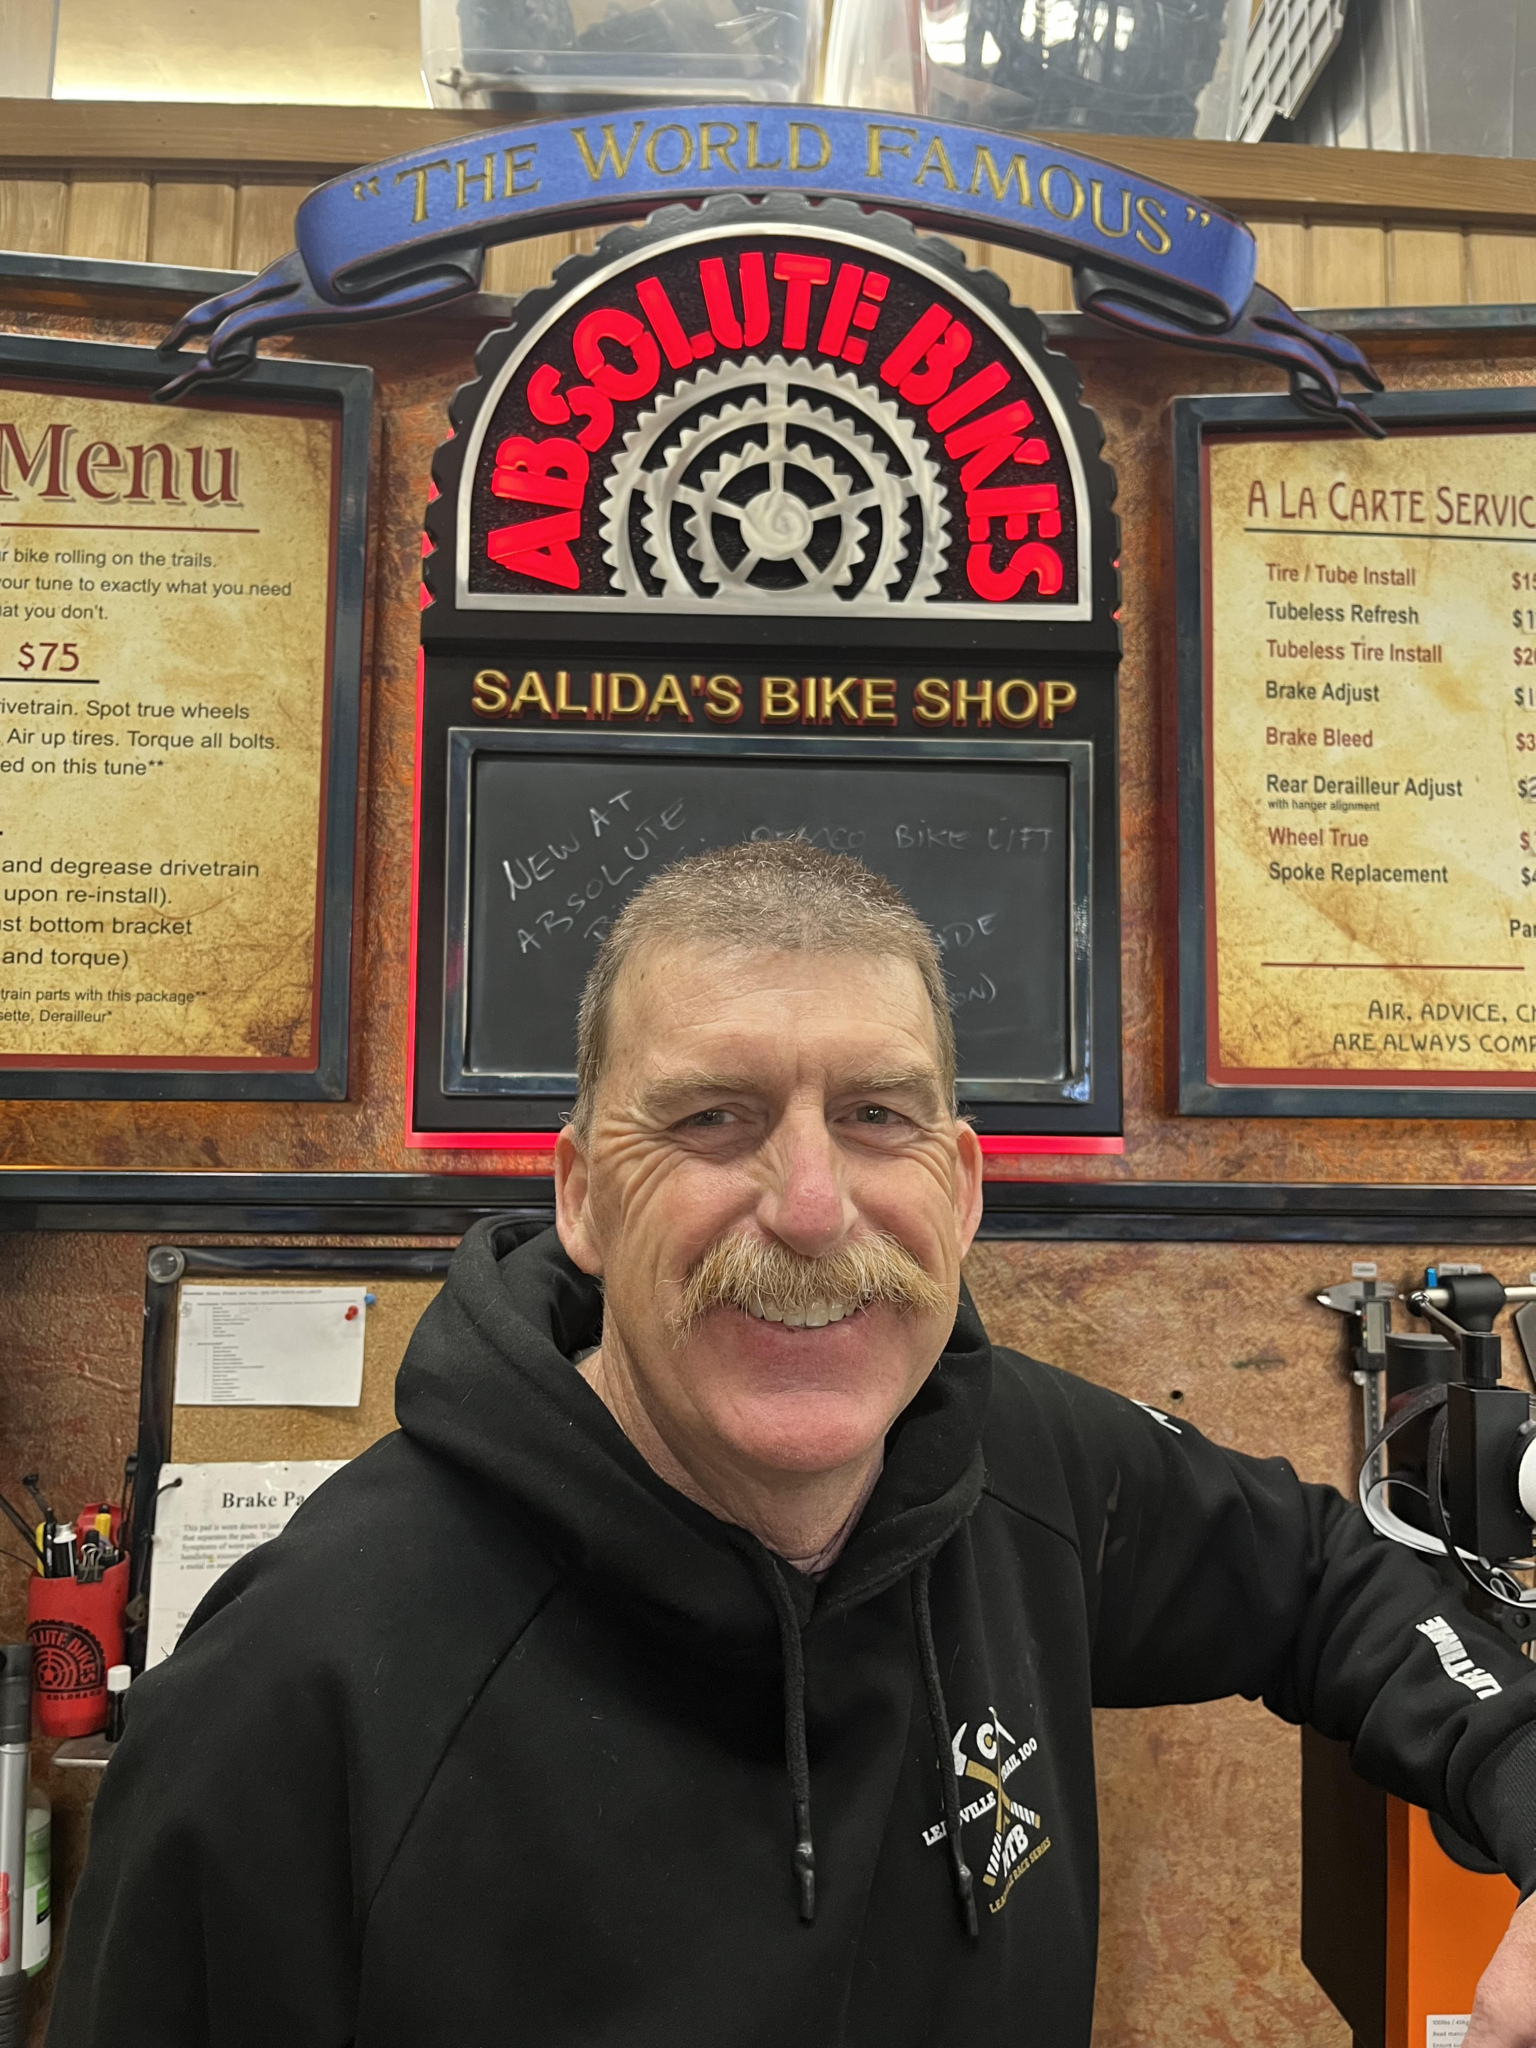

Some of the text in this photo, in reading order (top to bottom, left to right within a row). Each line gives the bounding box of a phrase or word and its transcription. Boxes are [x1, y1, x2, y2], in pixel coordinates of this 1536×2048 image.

[569, 120, 832, 182] WORLD
[487, 252, 1064, 602] ABSOLUTE BIKES
[0, 423, 241, 505] Menu
[1248, 480, 1268, 518] A
[1281, 481, 1317, 519] LA
[1328, 482, 1425, 524] CARTE
[14, 548, 49, 563] bike
[55, 549, 106, 569] rolling
[112, 553, 133, 567] on
[139, 552, 165, 567] the
[172, 553, 217, 568] trails.
[1266, 563, 1299, 582] Tire
[1316, 565, 1358, 584] Tube
[1364, 567, 1415, 586] Install
[0, 576, 291, 600] our tune to exactly what you need
[24, 606, 55, 621] you
[61, 604, 108, 620] don't.
[1266, 601, 1344, 622] Tubeless
[1351, 604, 1419, 625] Refresh
[18, 642, 80, 672] $75
[1266, 639, 1344, 660] Tubeless
[1351, 642, 1384, 661] Tire
[1390, 644, 1443, 663] Install
[472, 669, 1077, 730] SALIDA'S BIKE SHOP
[1266, 680, 1316, 700] Brake
[1322, 682, 1379, 706] Adjust
[0, 698, 250, 720] ivetrain. Spot true wheels
[7, 728, 280, 751] Air up tires. Torque all bolts.
[1266, 727, 1317, 746] Brake
[1324, 728, 1373, 748] Bleed
[31, 760, 55, 774] on
[63, 757, 97, 775] this
[1266, 774, 1308, 793] Rear
[1313, 775, 1399, 796] Derailleur
[1404, 778, 1462, 801] Adjust
[1268, 799, 1380, 814] with hanger alignment
[503, 790, 633, 901] NEW AT
[1268, 827, 1323, 846] Wheel
[1329, 828, 1369, 847] True
[2, 857, 260, 879] and degrease drivetrain
[517, 798, 687, 954] ABSOLUTE
[1269, 862, 1325, 885] Spoke
[1331, 863, 1448, 886] Replacement
[4, 886, 173, 908] upon re-install).
[30, 916, 104, 934] bottom
[112, 917, 193, 935] bracket
[2, 948, 129, 970] and torque)
[1, 988, 31, 1001] train
[36, 989, 71, 1003] parts
[75, 986, 103, 1002] with
[107, 989, 131, 1003] this
[1367, 1000, 1412, 1022] AIR,
[1421, 1003, 1508, 1023] ADVICE,
[1333, 1033, 1376, 1051] ARE
[1383, 1033, 1471, 1053] ALWAYS
[222, 1491, 277, 1509] Brake
[922, 1791, 997, 1847] LEVILLE
[1019, 1738, 1038, 1762] 100
